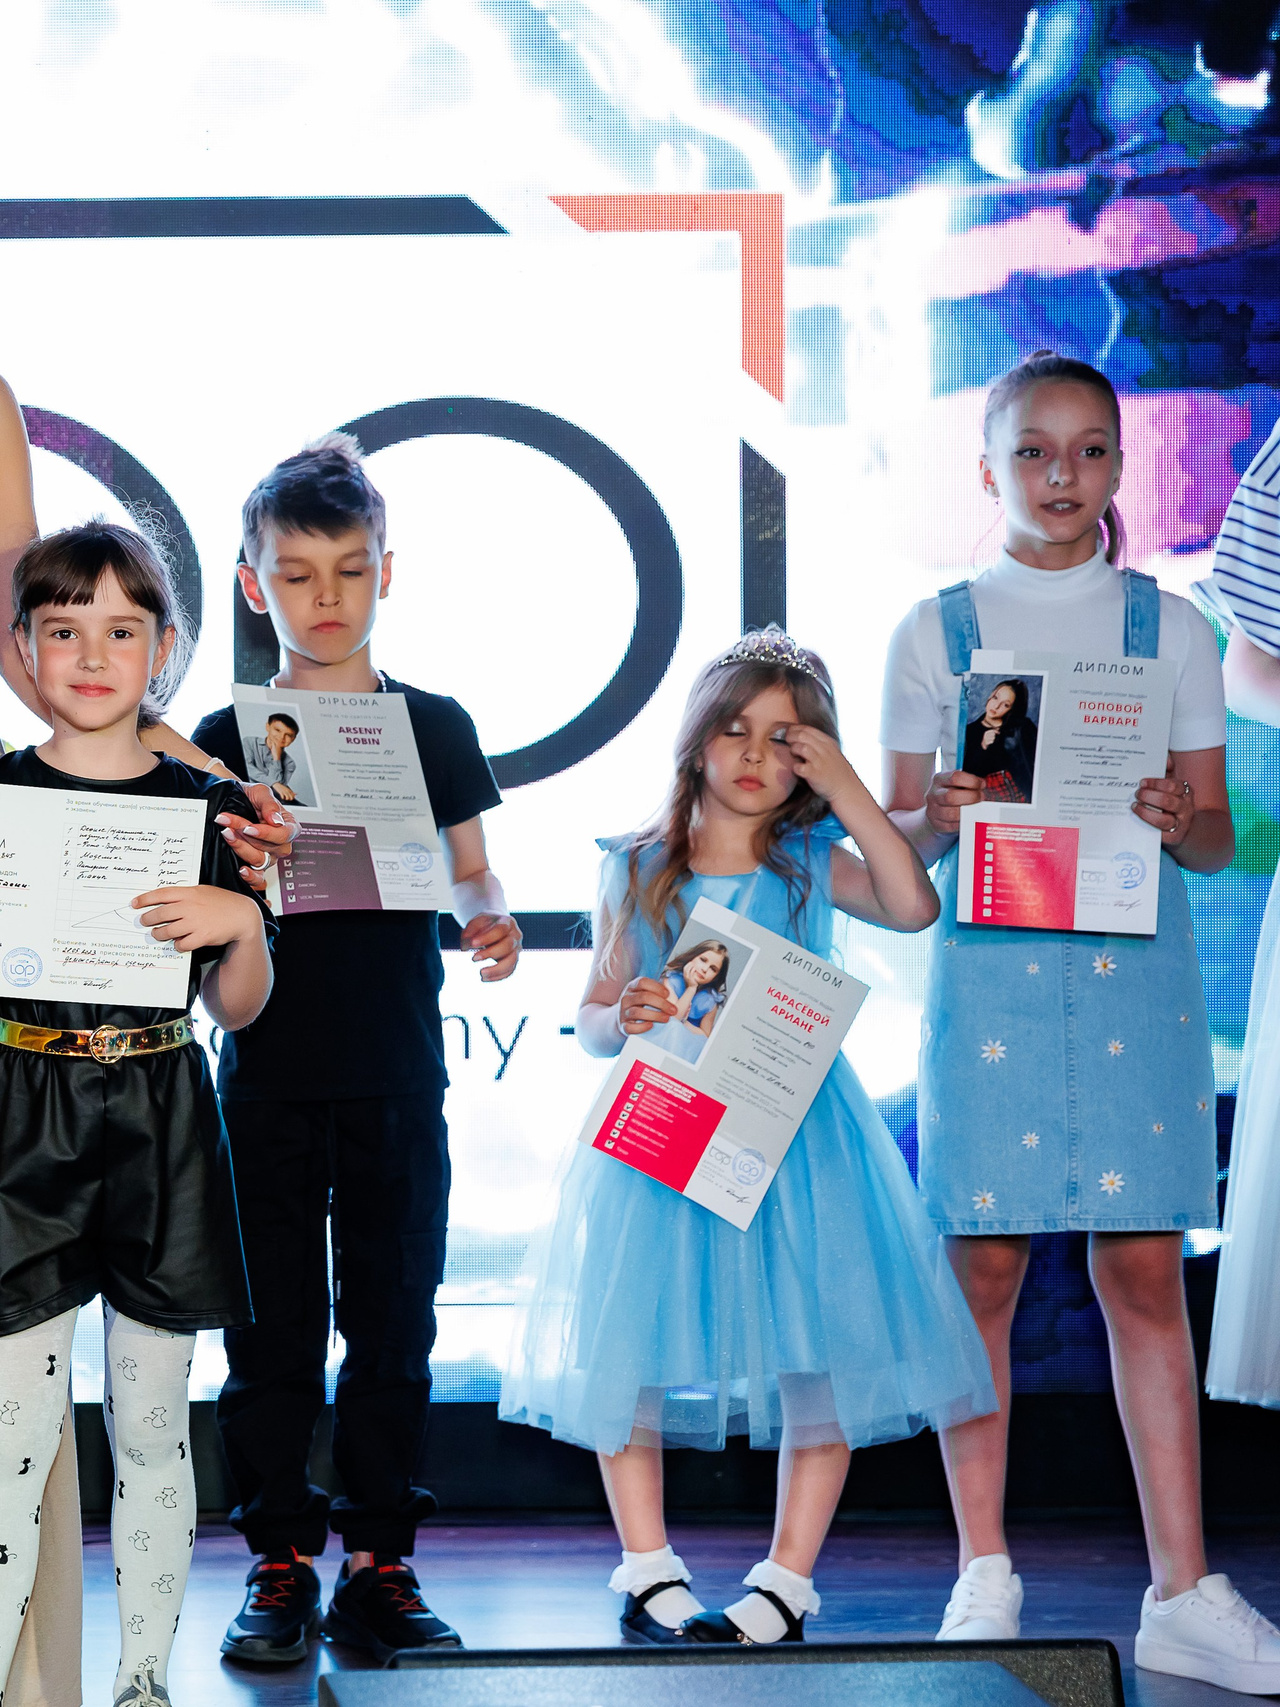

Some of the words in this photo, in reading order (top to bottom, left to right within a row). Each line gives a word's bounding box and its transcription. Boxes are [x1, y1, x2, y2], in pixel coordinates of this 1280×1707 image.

[1074, 662, 1143, 675] ДИПЛОМ
[318, 697, 379, 706] DIPLOMA
[1079, 701, 1142, 714] ПОПОВОЙ
[1084, 715, 1139, 727] ВАРВАРЕ
[339, 726, 382, 735] ARSENIY
[346, 737, 380, 745] ROBIN
[53, 938, 87, 946] Решением
[782, 952, 843, 988] ДИПЛОМ
[771, 1005, 814, 1033] АРИАНЕ
